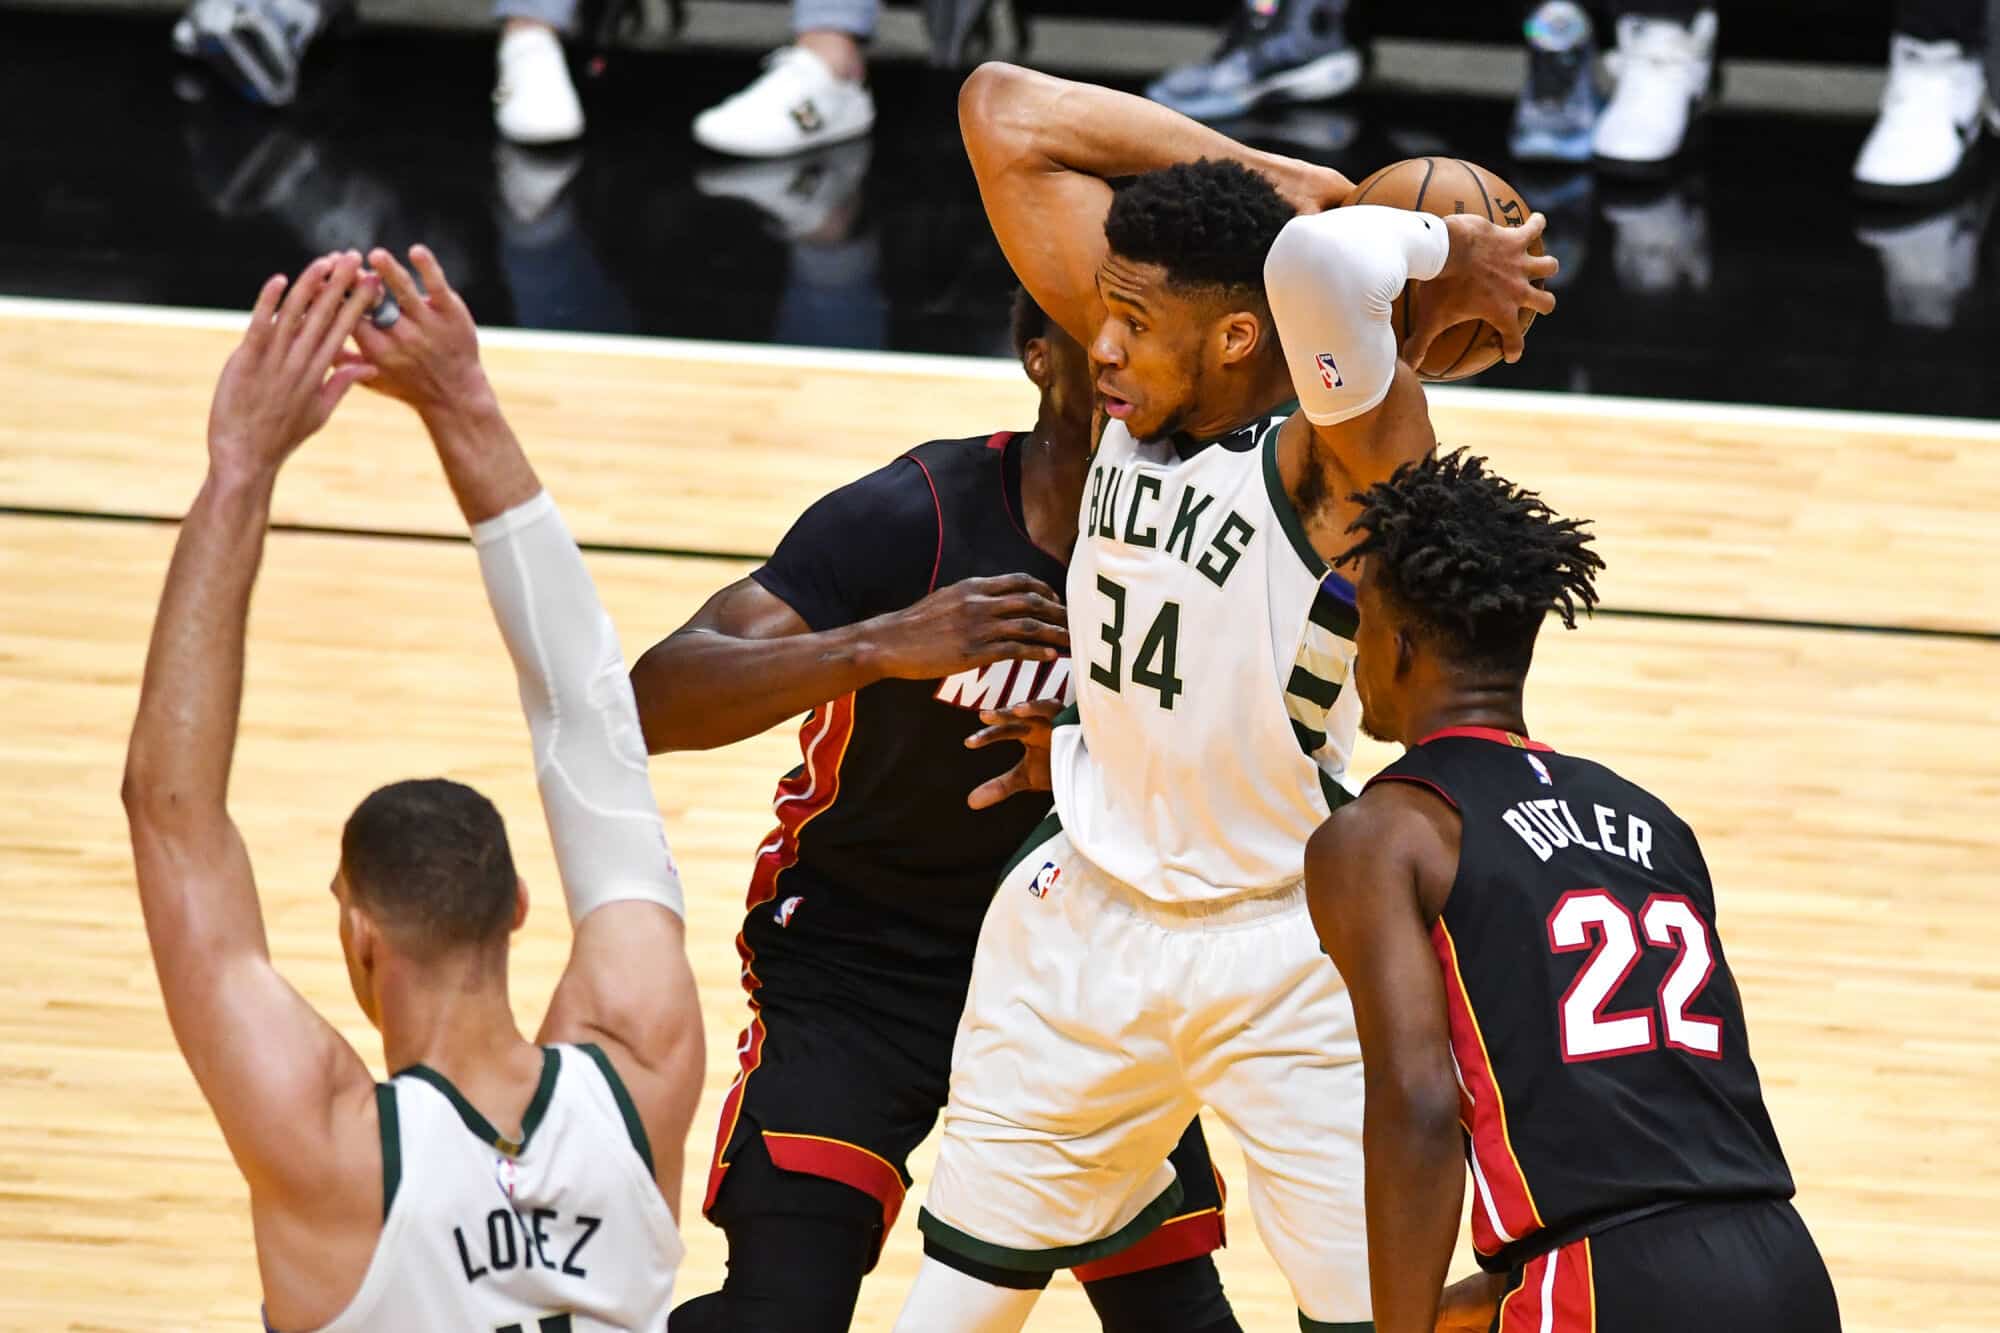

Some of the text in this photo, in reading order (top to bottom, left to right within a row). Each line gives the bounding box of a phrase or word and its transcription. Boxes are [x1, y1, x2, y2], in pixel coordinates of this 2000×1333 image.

[1088, 466, 1256, 588] BUCKS
[1090, 574, 1183, 711] 34
[1502, 799, 1654, 870] BUTLER
[1546, 888, 1723, 1064] 22
